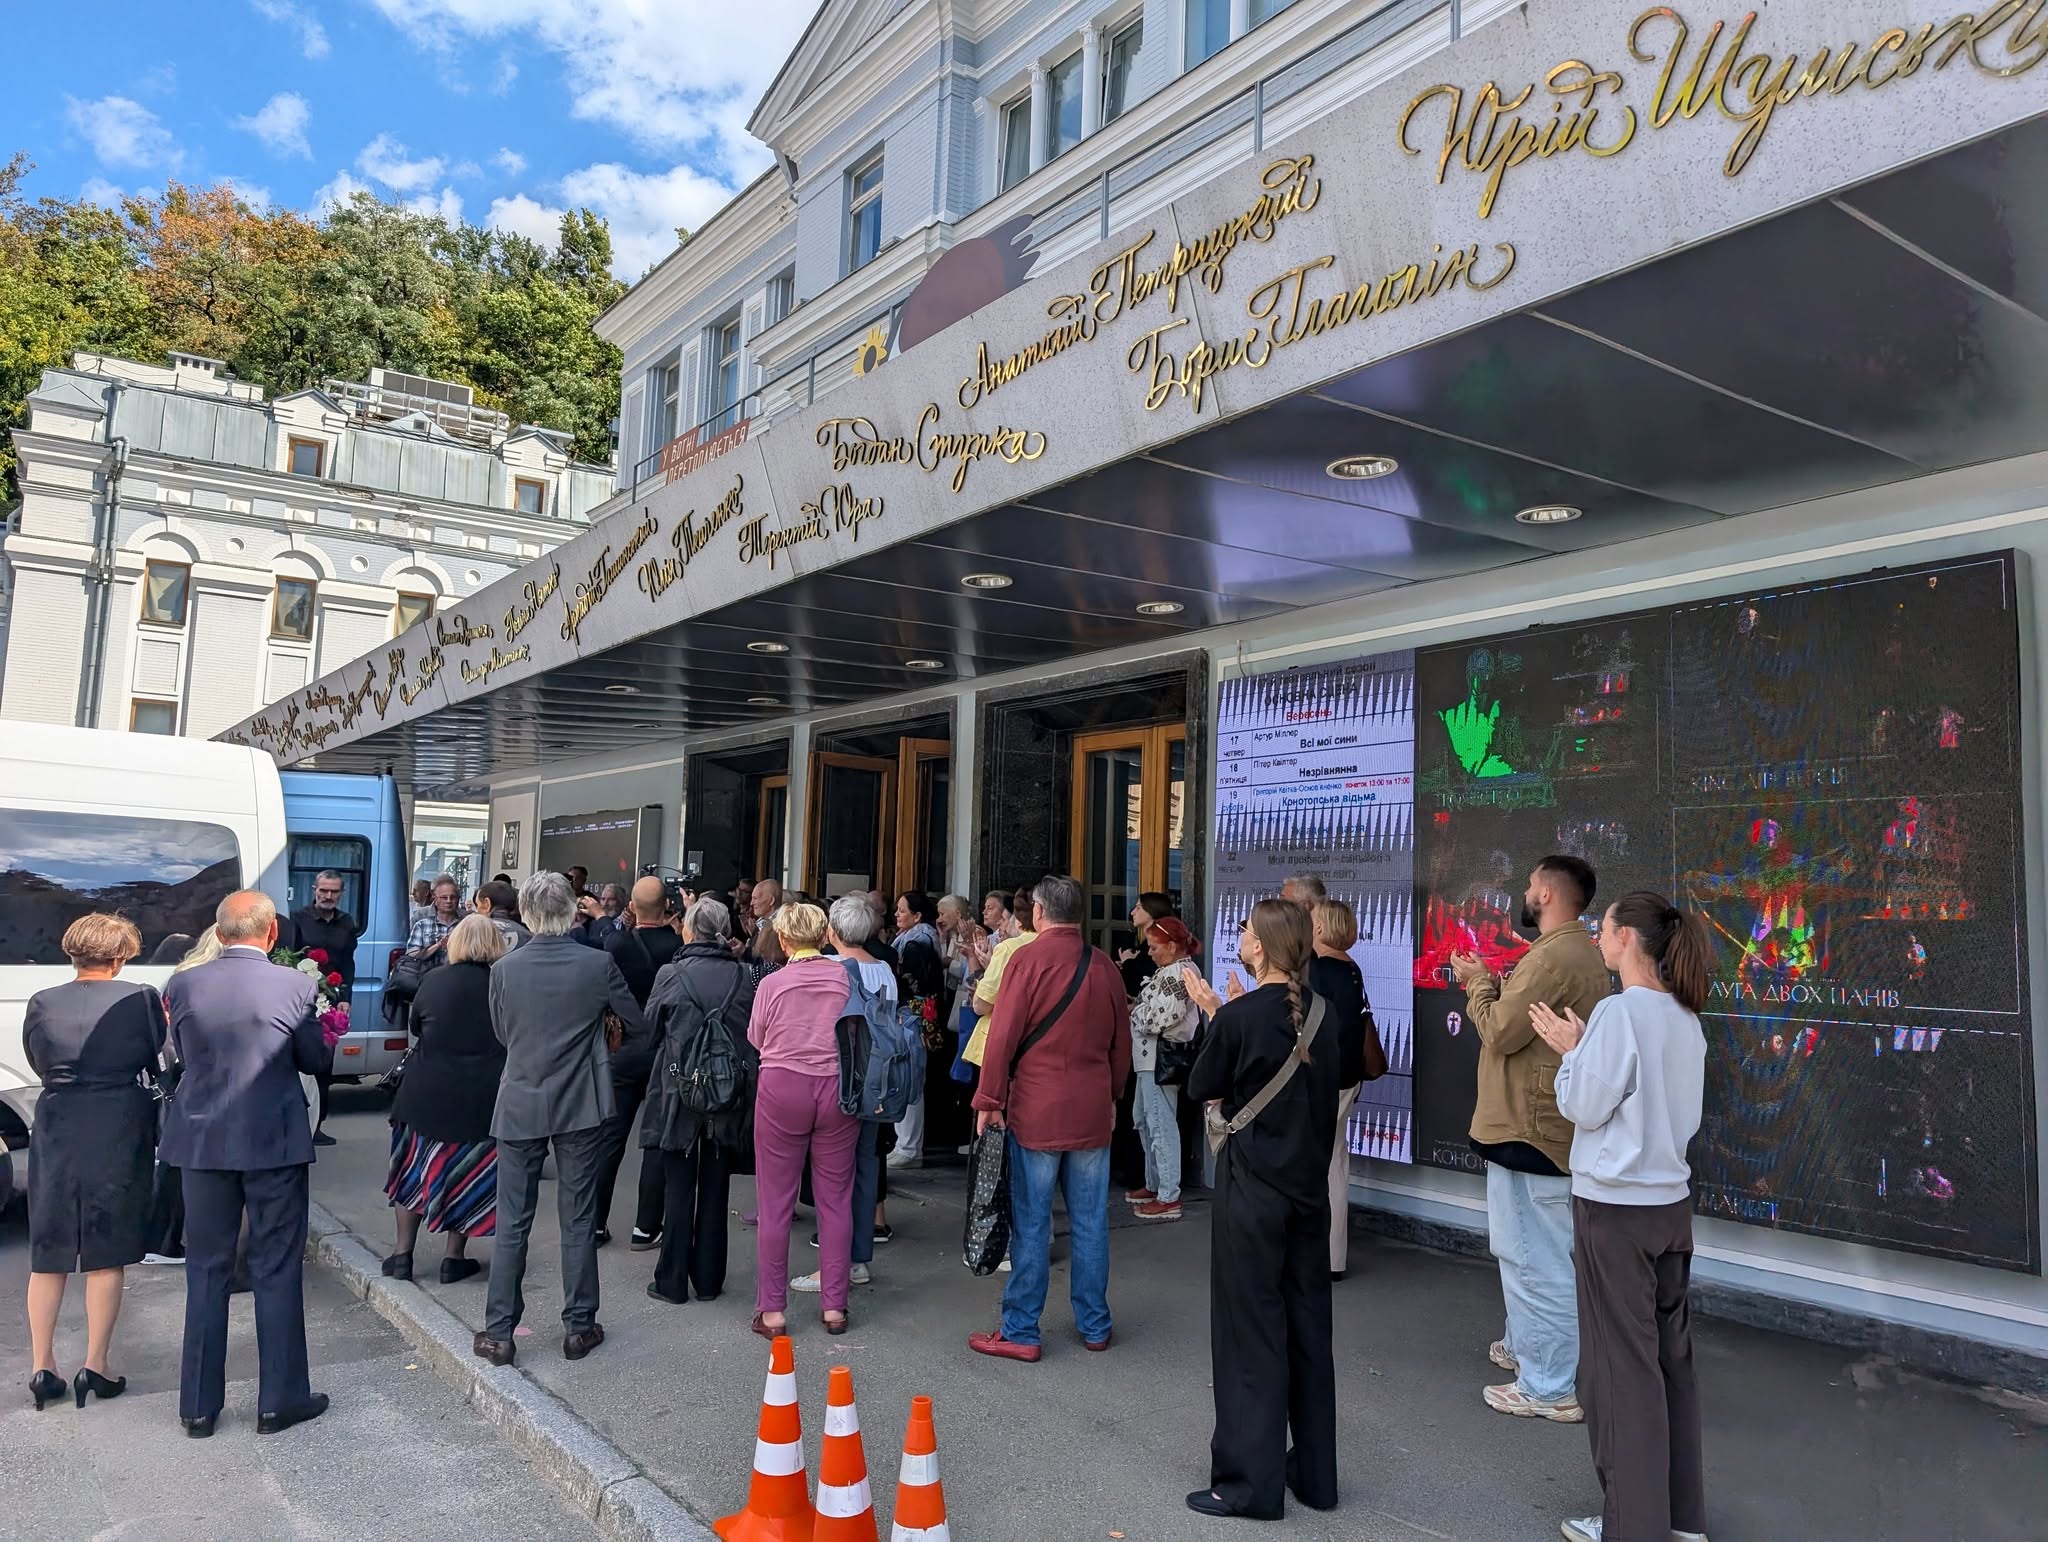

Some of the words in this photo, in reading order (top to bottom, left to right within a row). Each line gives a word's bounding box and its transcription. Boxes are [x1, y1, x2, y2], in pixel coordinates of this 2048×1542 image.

[1398, 57, 1637, 220] Юрій
[1628, 0, 2048, 178] Шумськи
[957, 293, 1099, 409] Анатолій
[1087, 153, 1323, 324] Петрицький
[1127, 318, 1272, 415] Борис
[1246, 243, 1517, 352] Глаголін
[662, 448, 669, 469] У
[671, 432, 697, 464] ВОГНІ
[815, 416, 914, 473] Богдан
[914, 402, 1047, 494] Ступка
[738, 502, 830, 571] Терентій
[820, 482, 884, 543] Юра
[1230, 736, 1239, 745] 17
[1300, 737, 1315, 748] Всі
[1317, 735, 1332, 747] мої
[1334, 735, 1358, 745] сини
[1299, 765, 1358, 778] Незрівнянна
[1229, 790, 1238, 800] 19
[1282, 795, 1340, 807] Конотопська
[1342, 792, 1377, 804] відьма
[1707, 981, 1758, 1000] ЛУГА
[1763, 984, 1824, 1004] ДВОХ
[1830, 986, 1900, 1008] ПАНІВ
